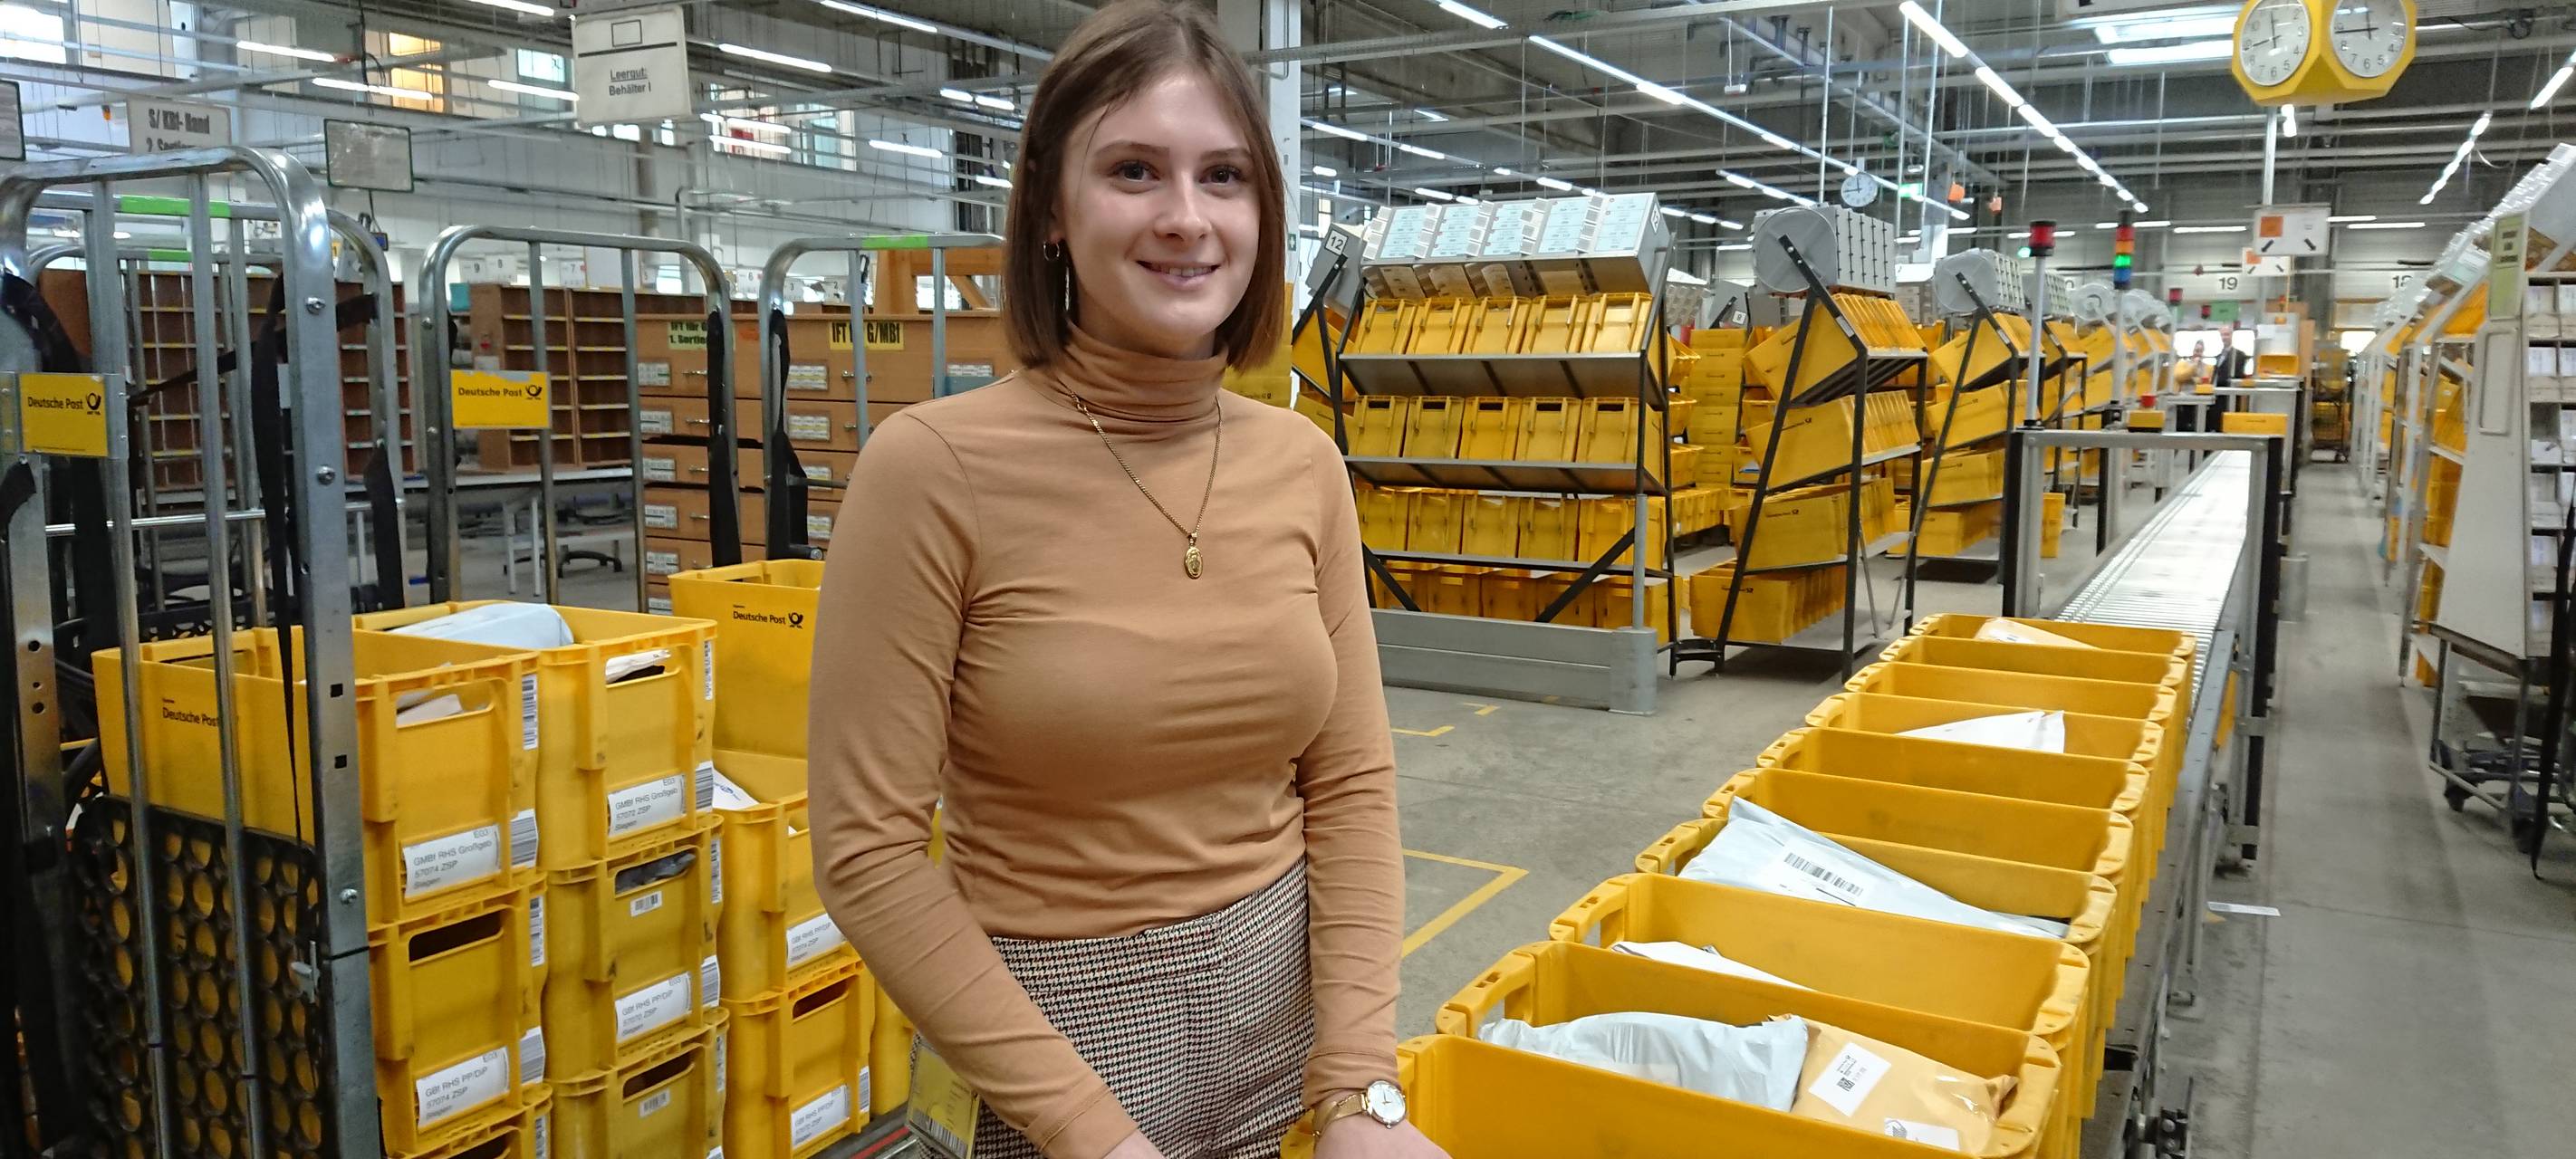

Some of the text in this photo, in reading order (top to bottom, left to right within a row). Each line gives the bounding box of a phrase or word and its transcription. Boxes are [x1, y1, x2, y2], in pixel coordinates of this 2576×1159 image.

[2363, 57, 2370, 70] 6
[610, 66, 648, 81] Leergut:
[2271, 66, 2277, 78] 6
[608, 82, 646, 97] Behälter
[1331, 235, 1343, 251] 12
[2219, 277, 2238, 291] 19
[678, 334, 706, 344] Sortie
[831, 321, 848, 343] IFT
[457, 387, 523, 398] Deutsche Post
[27, 396, 83, 410] Deutsche Post
[732, 610, 786, 625] Deutsche Post
[163, 706, 200, 724] Deutsche
[437, 848, 457, 859] RHS
[442, 1078, 460, 1091] RHS
